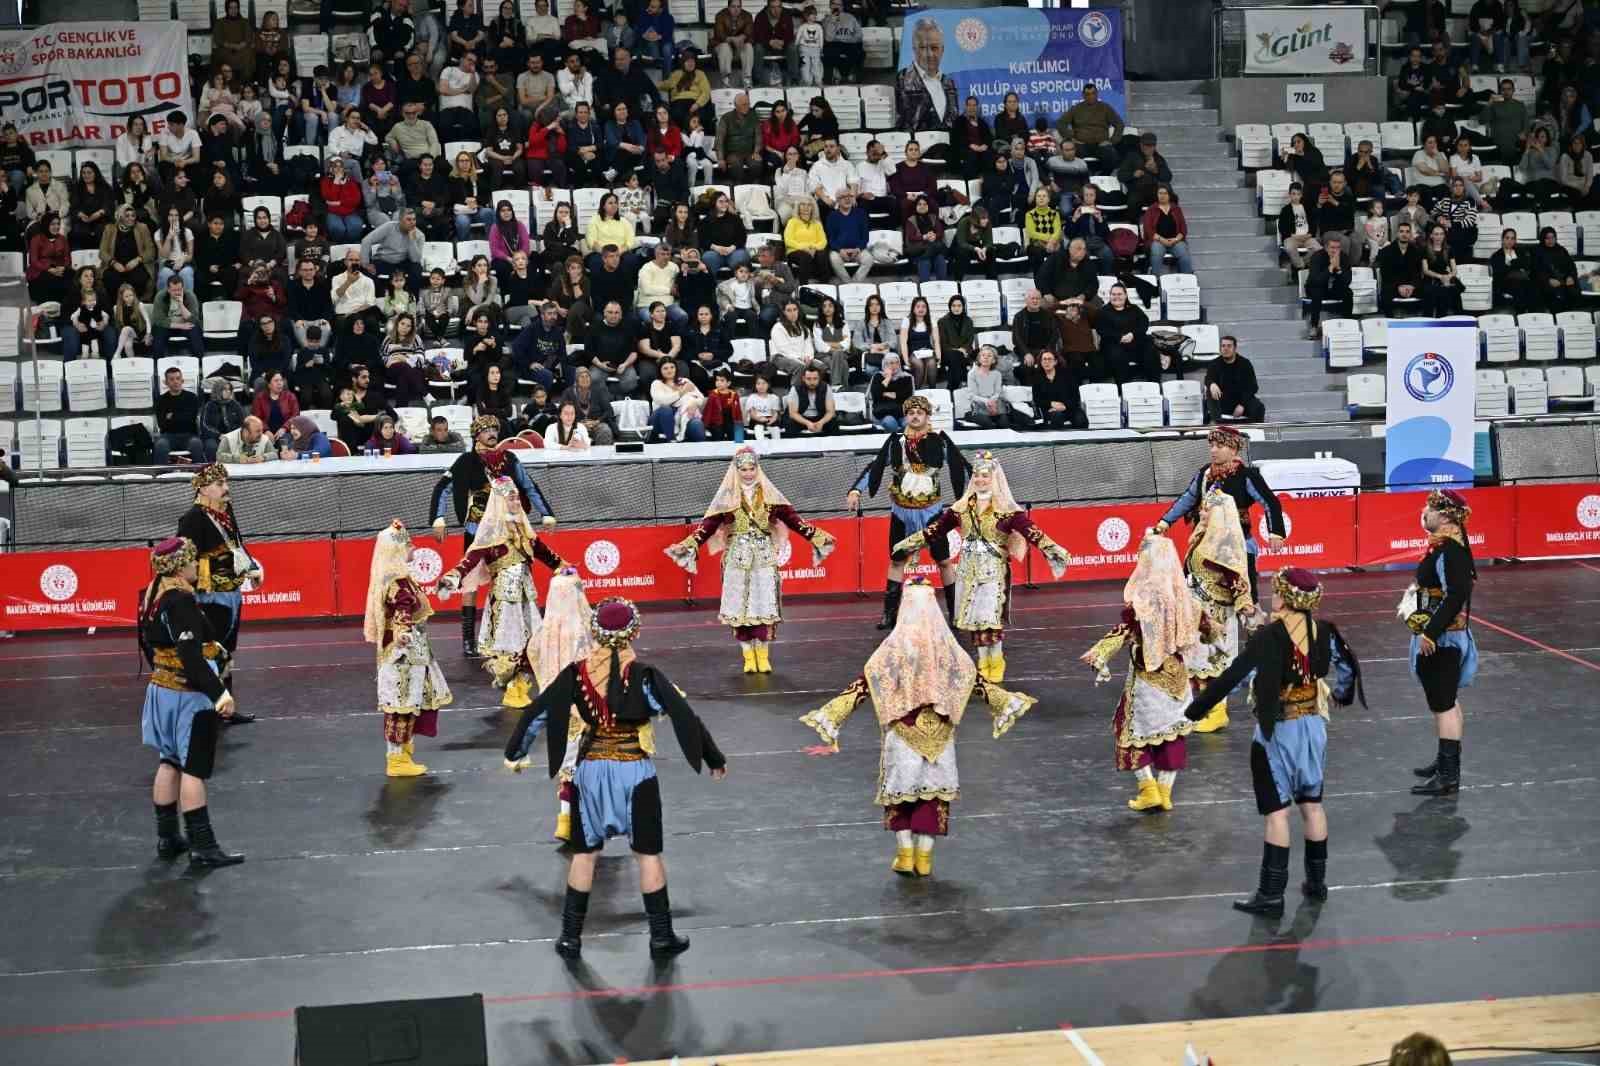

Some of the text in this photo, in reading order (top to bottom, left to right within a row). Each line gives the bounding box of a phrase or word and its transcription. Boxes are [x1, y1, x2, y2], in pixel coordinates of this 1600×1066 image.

[32, 37, 56, 49] T.C.
[57, 29, 118, 44] GENÇLİK
[119, 29, 136, 41] VE
[31, 44, 142, 66] SPOR BAKANLIĞI
[1009, 58, 1070, 75] KATILIMCI
[0, 71, 182, 117] PORTOTO
[969, 79, 1009, 97] KULÜP
[1012, 84, 1028, 94] ve
[1294, 92, 1316, 103] 702
[17, 124, 103, 146] ARILAR
